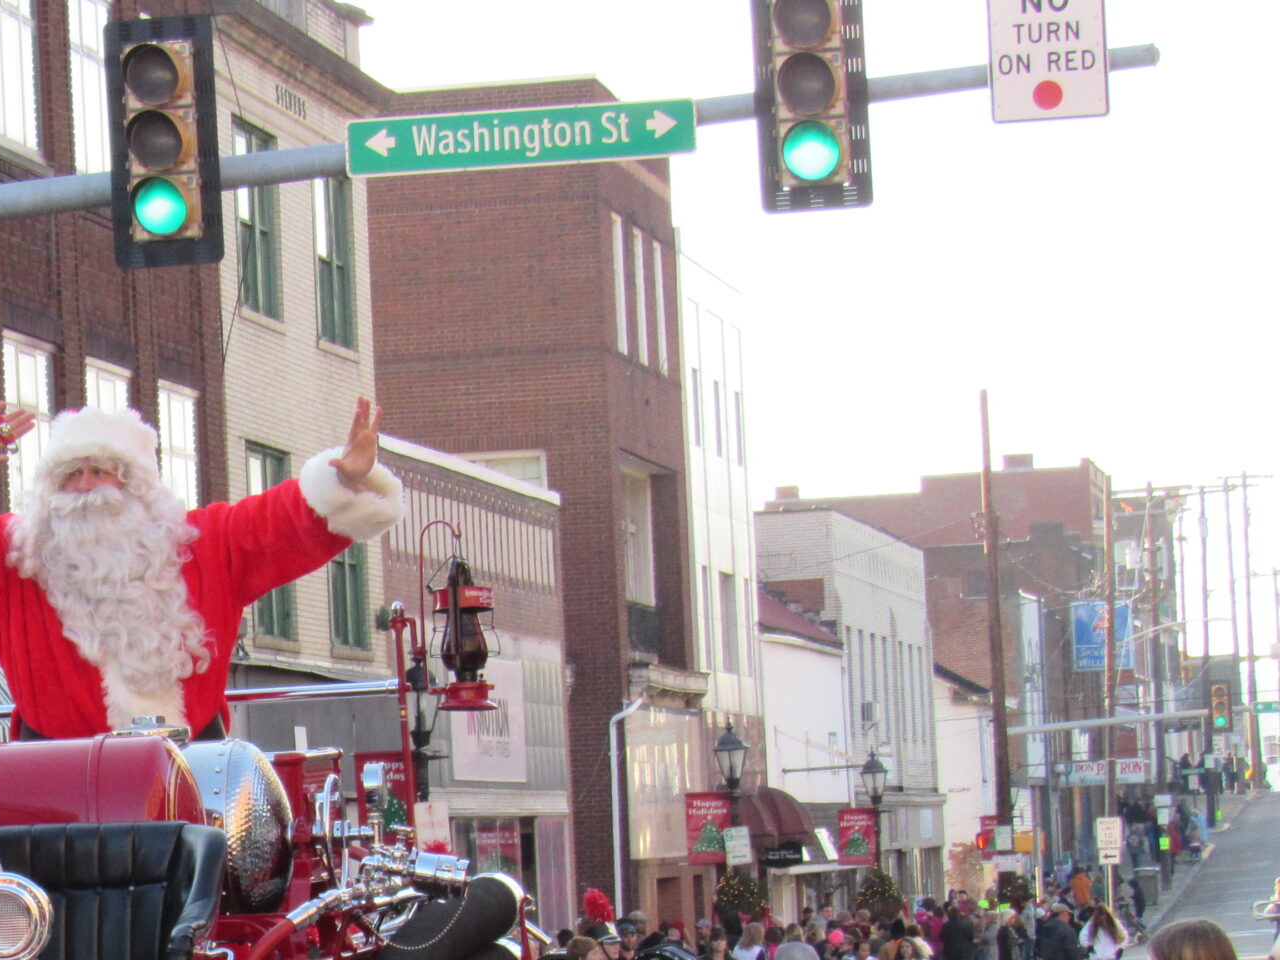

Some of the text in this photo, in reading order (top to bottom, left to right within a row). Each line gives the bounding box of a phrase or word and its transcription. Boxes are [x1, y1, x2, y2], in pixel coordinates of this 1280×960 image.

[1012, 20, 1080, 44] TURN
[998, 49, 1096, 76] ON RED
[411, 111, 630, 158] Washington St
